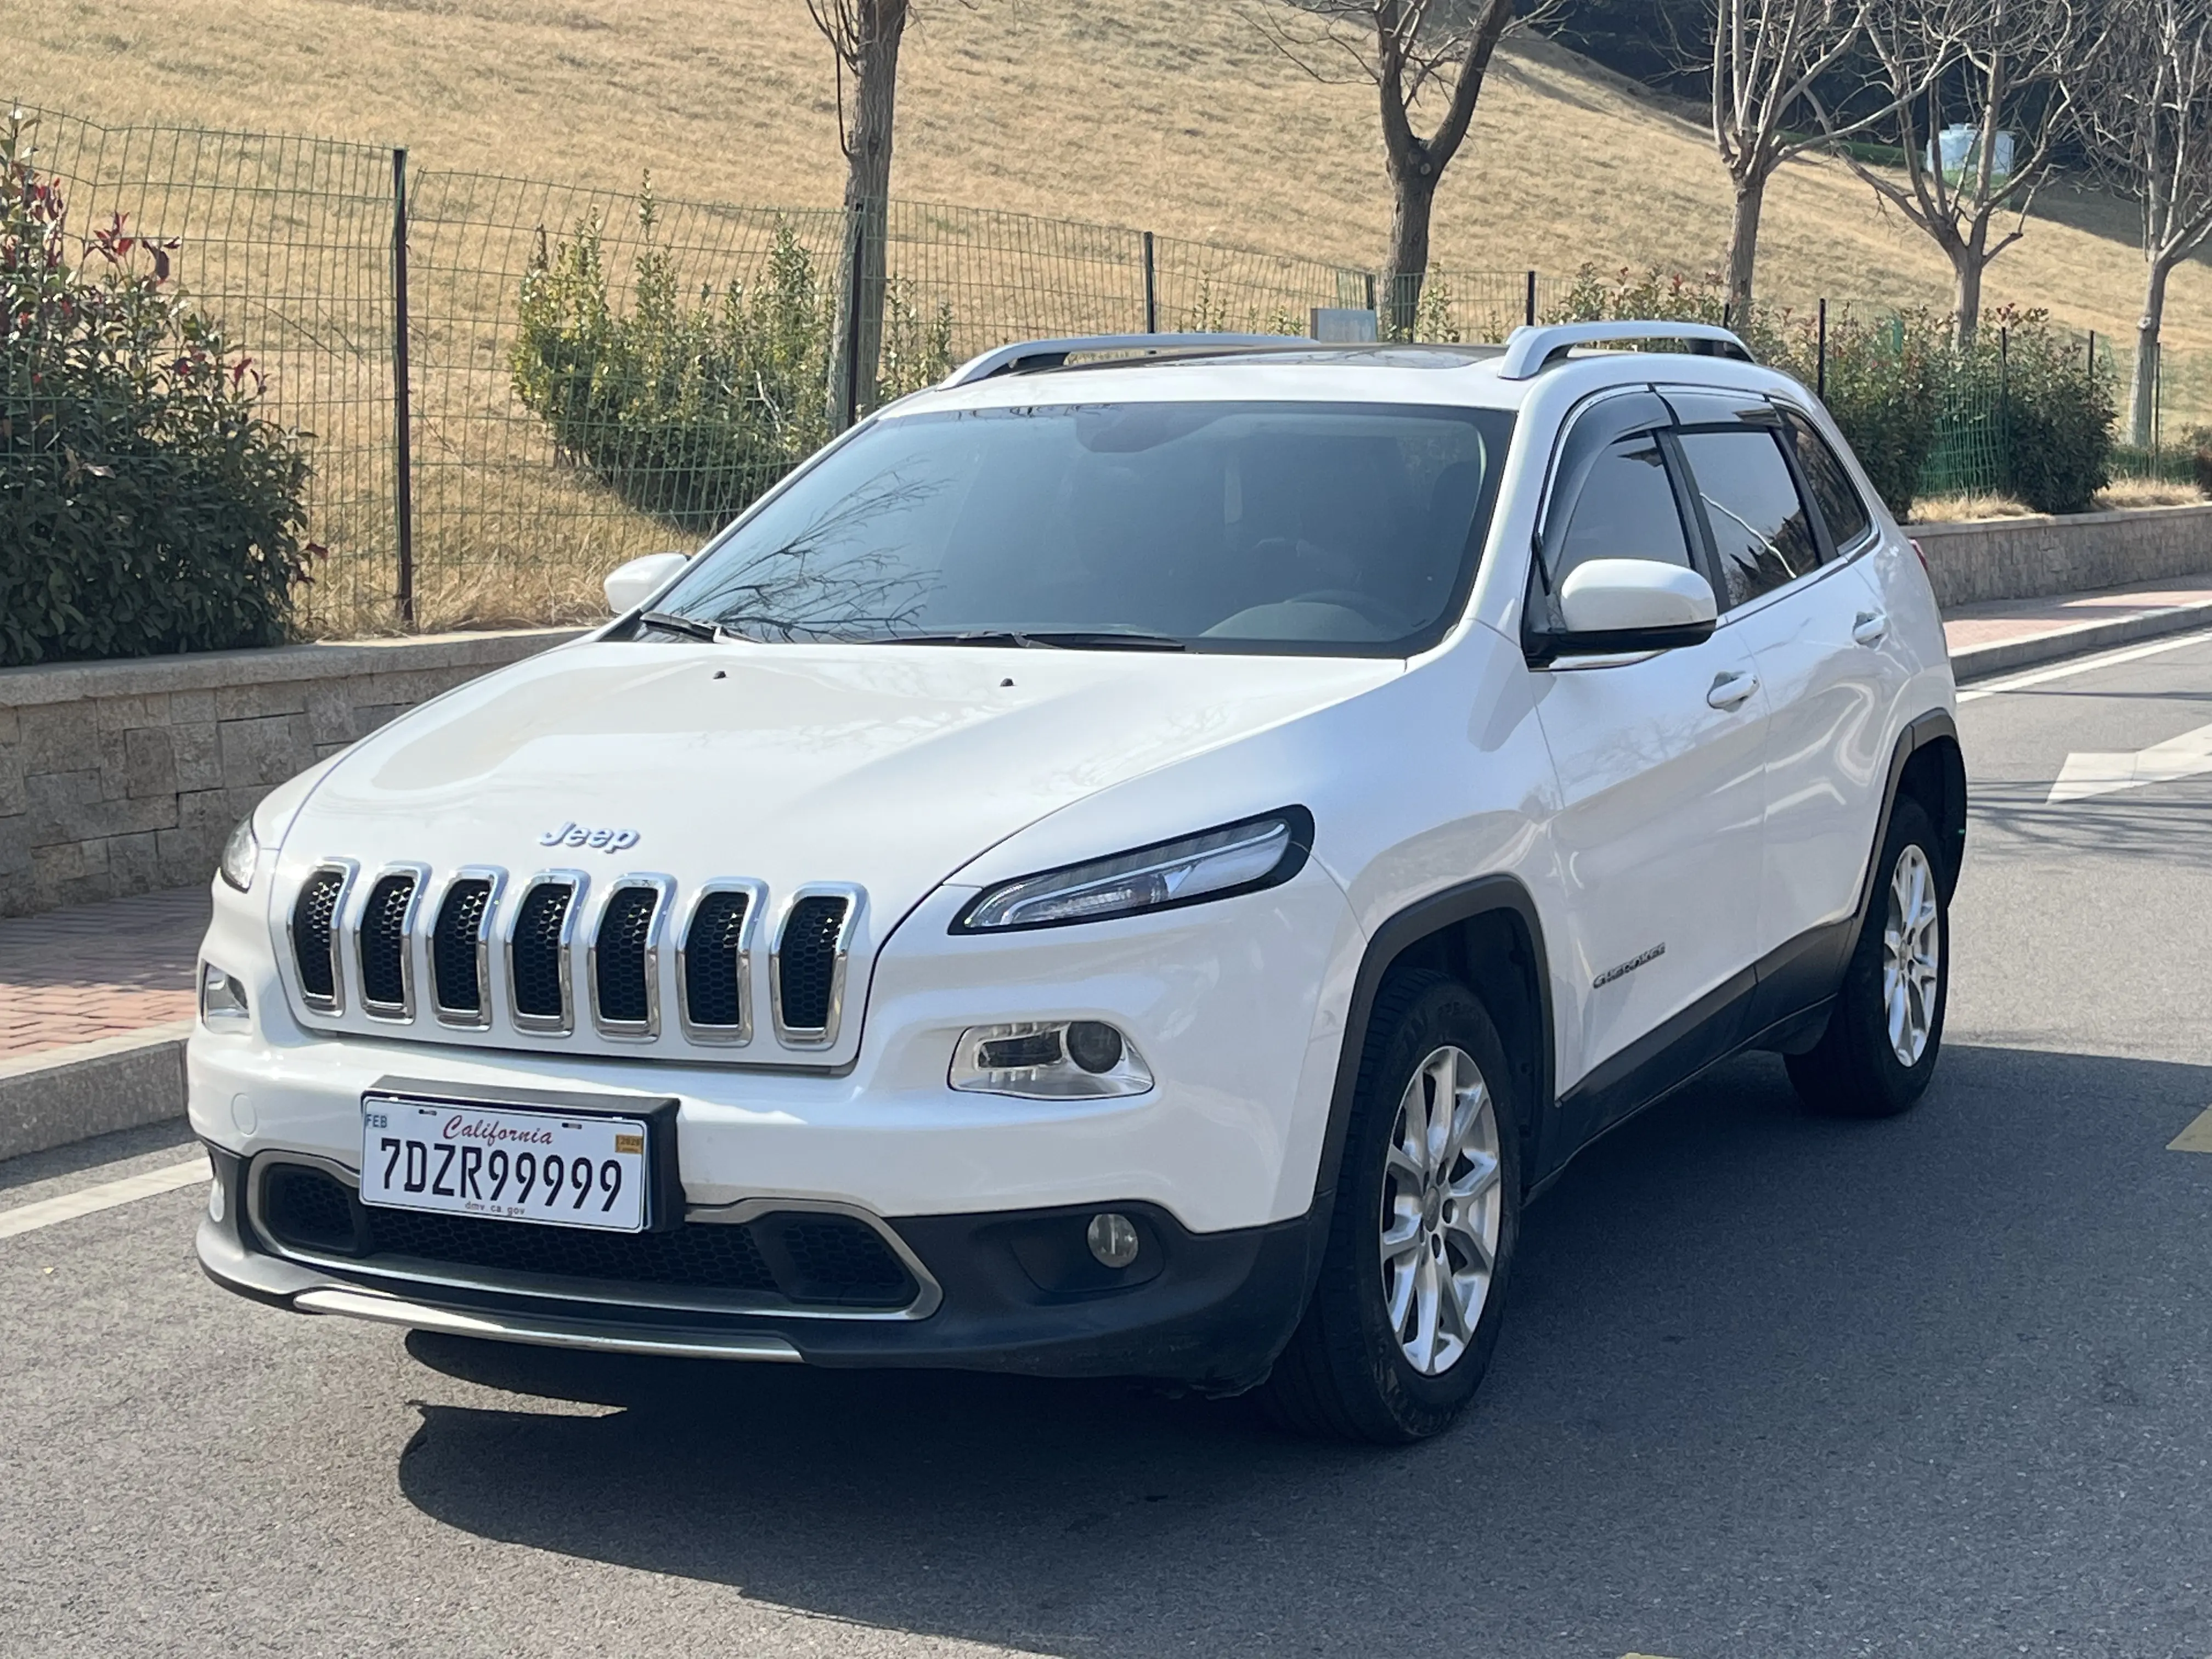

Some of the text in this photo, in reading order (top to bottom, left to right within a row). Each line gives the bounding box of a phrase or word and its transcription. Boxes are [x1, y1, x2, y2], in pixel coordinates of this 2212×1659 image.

[538, 821, 640, 854] Jeep
[365, 1114, 387, 1128] FEB
[443, 1115, 553, 1147] California
[381, 1137, 622, 1212] 7DZR99999
